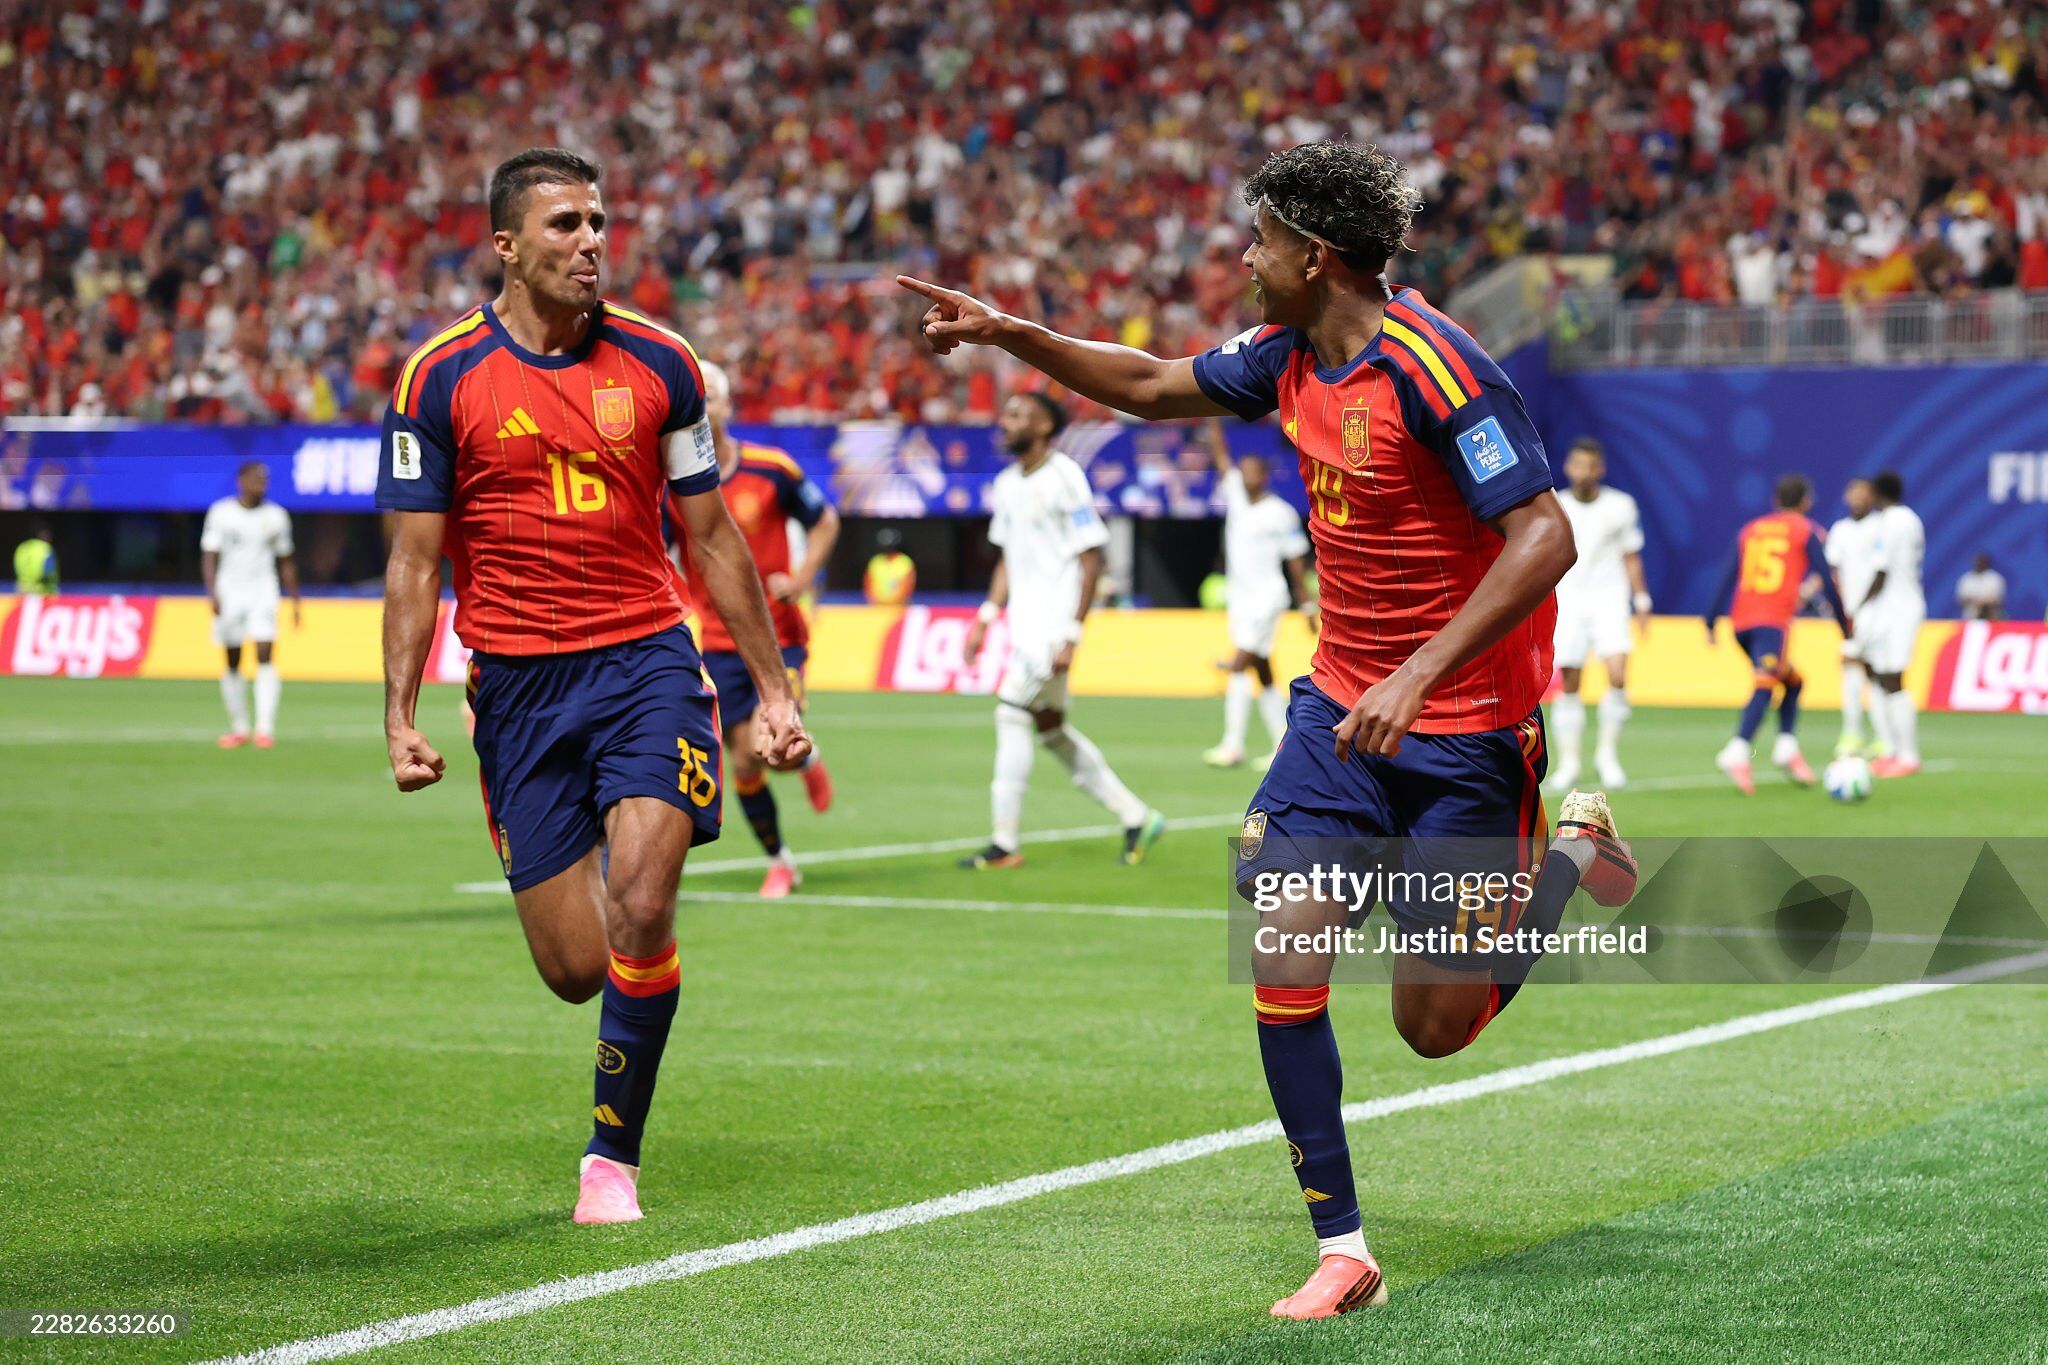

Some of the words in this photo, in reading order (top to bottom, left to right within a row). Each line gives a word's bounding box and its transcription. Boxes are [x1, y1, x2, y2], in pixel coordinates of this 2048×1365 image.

[546, 450, 607, 515] 16
[1311, 458, 1349, 527] 19
[1480, 451, 1502, 468] PEACE
[11, 594, 143, 679] Lay's
[676, 737, 717, 807] 16
